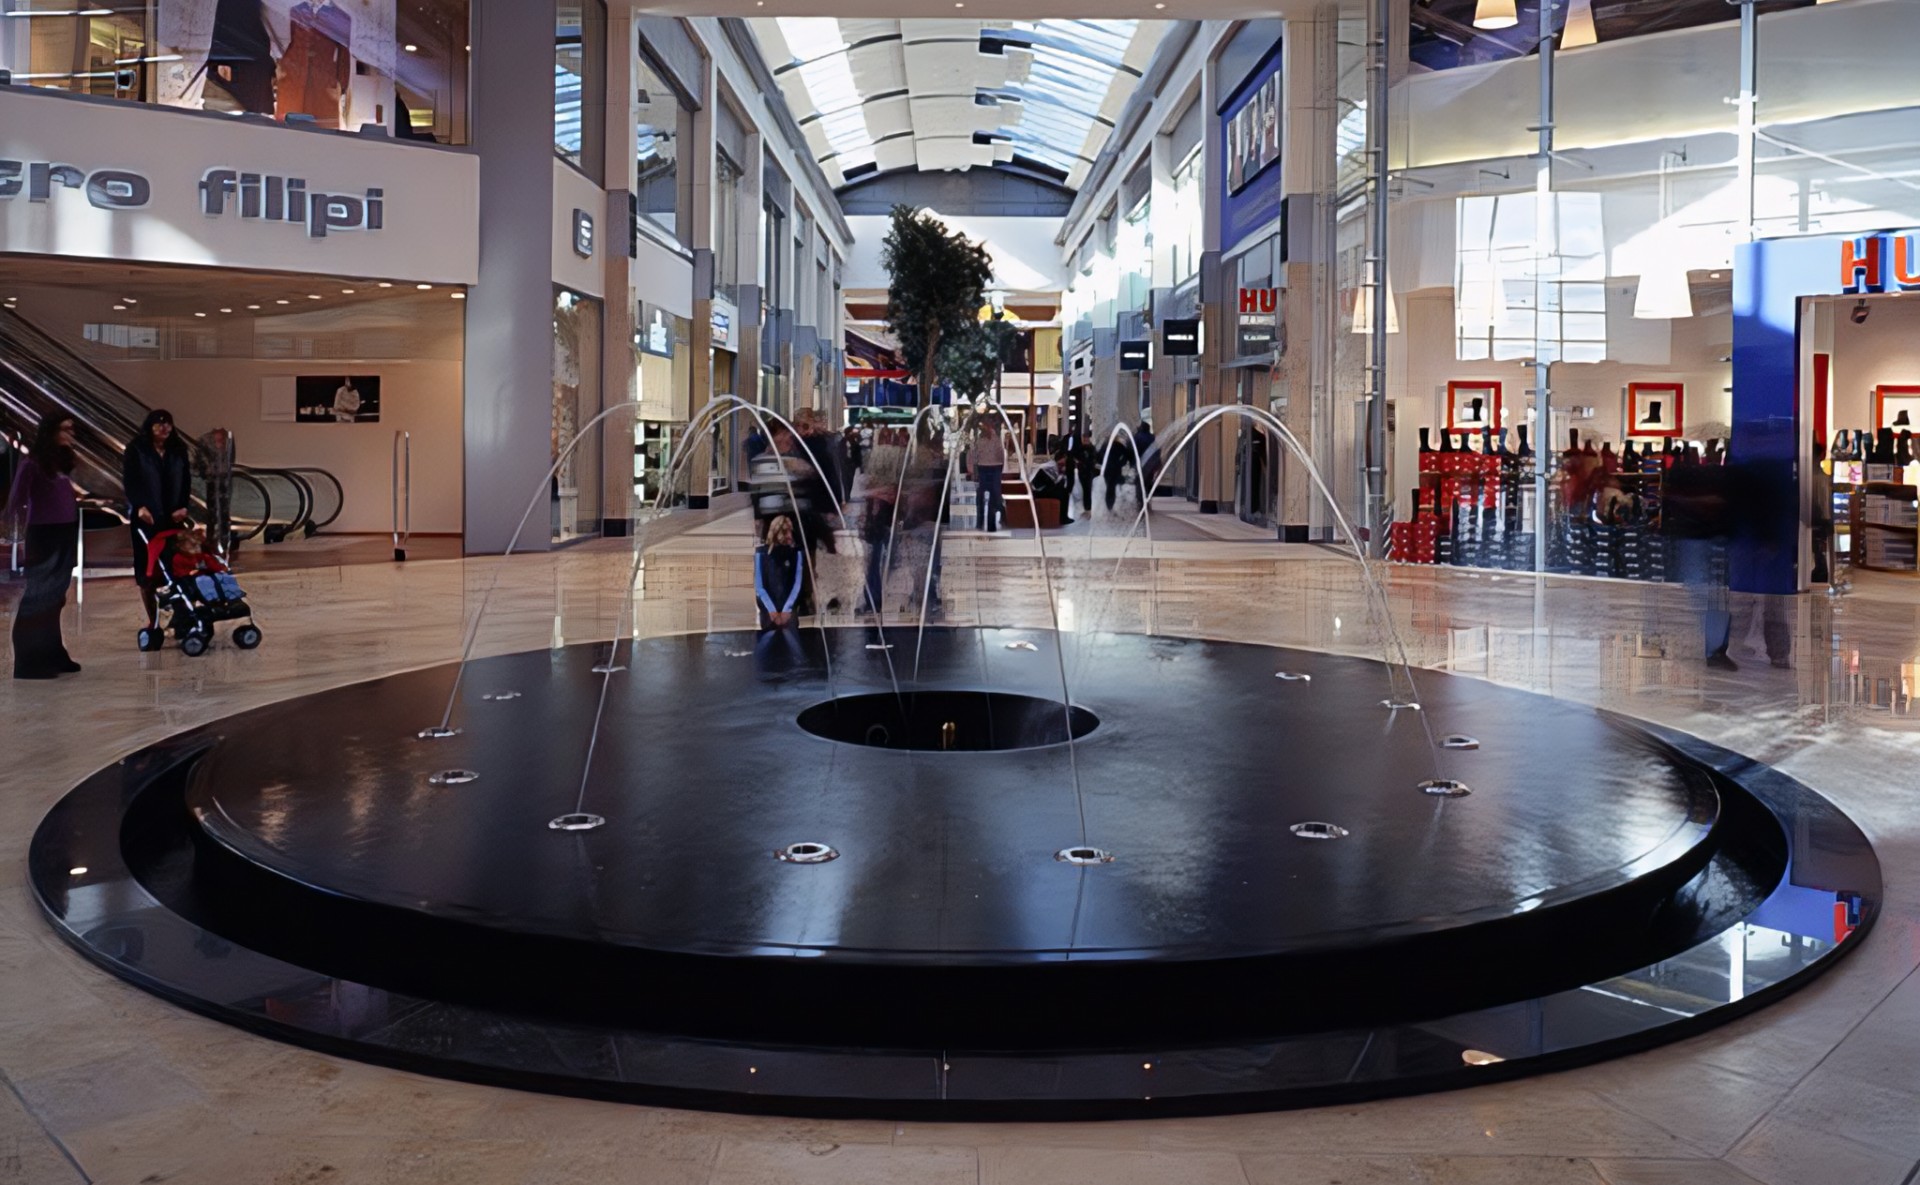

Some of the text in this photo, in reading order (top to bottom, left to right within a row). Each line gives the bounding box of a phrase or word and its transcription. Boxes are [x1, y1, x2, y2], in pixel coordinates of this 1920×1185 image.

[199, 166, 383, 238] filipi
[1841, 235, 1920, 287] HU
[1239, 287, 1277, 313] HU
